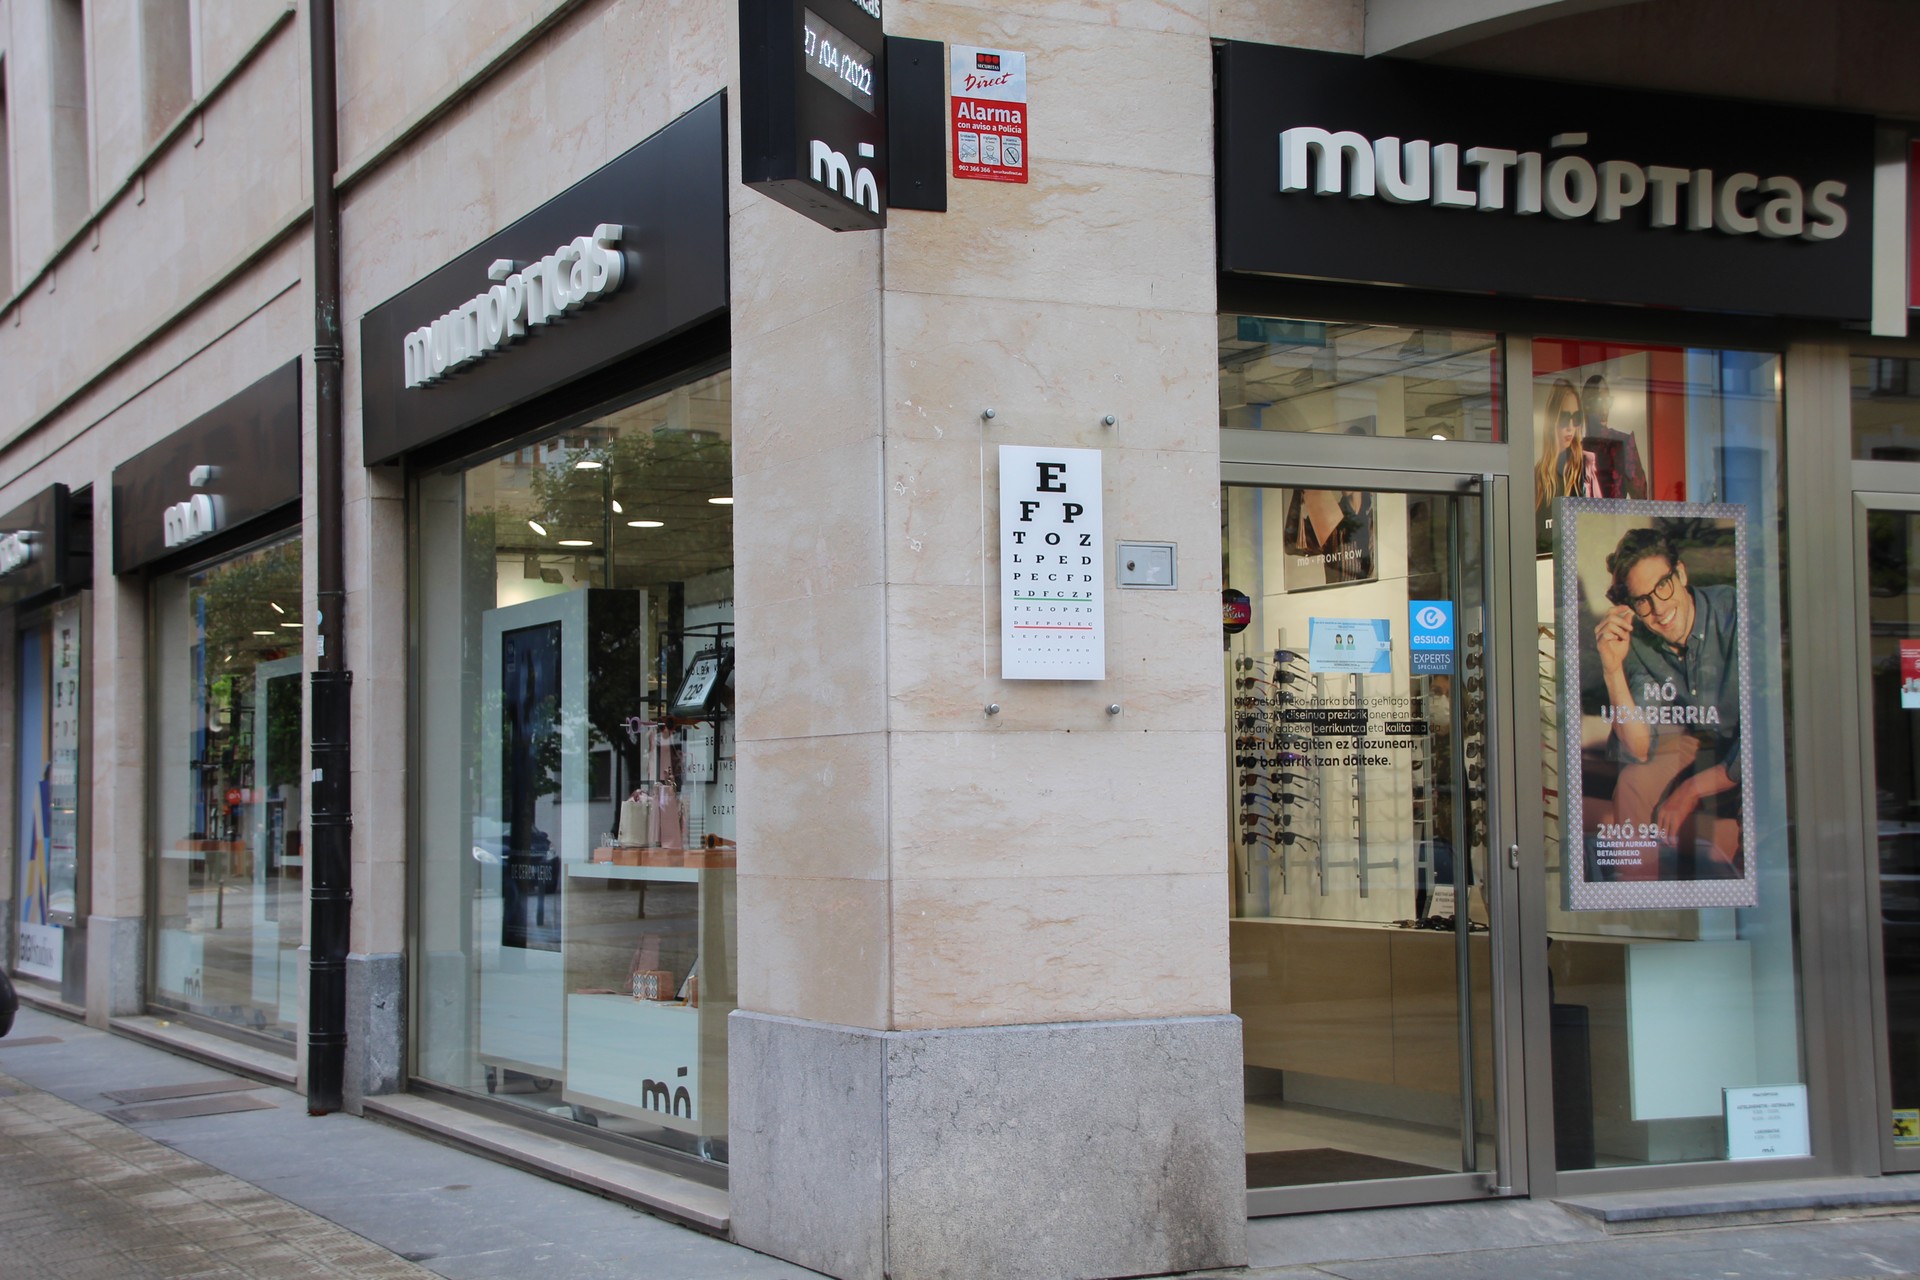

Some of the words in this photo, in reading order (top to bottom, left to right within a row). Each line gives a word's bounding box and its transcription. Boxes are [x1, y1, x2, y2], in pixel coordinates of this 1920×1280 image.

[964, 72, 1014, 92] Direct
[957, 101, 1022, 124] Alarma
[957, 121, 971, 129] con
[972, 122, 991, 131] aviso
[998, 124, 1022, 134] Policía
[1036, 462, 1066, 493] E
[1020, 501, 1040, 522] F
[1062, 503, 1083, 523] P
[1013, 531, 1026, 544] T
[1045, 532, 1061, 546] O
[1079, 534, 1091, 546] Z
[1013, 554, 1021, 563] L
[1036, 555, 1044, 563] P
[1059, 555, 1068, 564] E
[1082, 556, 1091, 565] D
[1316, 552, 1342, 564] FRONT
[1345, 549, 1362, 560] ROW
[1413, 653, 1450, 664] EXPERTS
[1643, 676, 1677, 701] MÓ
[1371, 696, 1409, 708] gehiago
[1287, 709, 1326, 720] diseinua
[1328, 709, 1368, 722] preziorik
[1369, 711, 1410, 719] onenean
[1600, 704, 1720, 725] UDABERRIA
[1234, 723, 1273, 735] Mugarik
[1275, 723, 1310, 735] gabeko
[1313, 723, 1366, 733] berrikuntza
[1368, 725, 1384, 733] eta
[1386, 722, 1426, 733] kalitatea
[1268, 738, 1290, 751] uko
[1293, 738, 1333, 753] egiten
[1336, 740, 1349, 750] ez
[1352, 737, 1418, 751] diozunean,
[1260, 754, 1312, 767] bakarrik
[1314, 755, 1340, 767] izan
[1343, 754, 1392, 767] daiteke.
[1596, 818, 1634, 840] 2MÓ
[1596, 849, 1640, 857] BETAURREKO
[1596, 858, 1642, 866] GRADUATUAK
